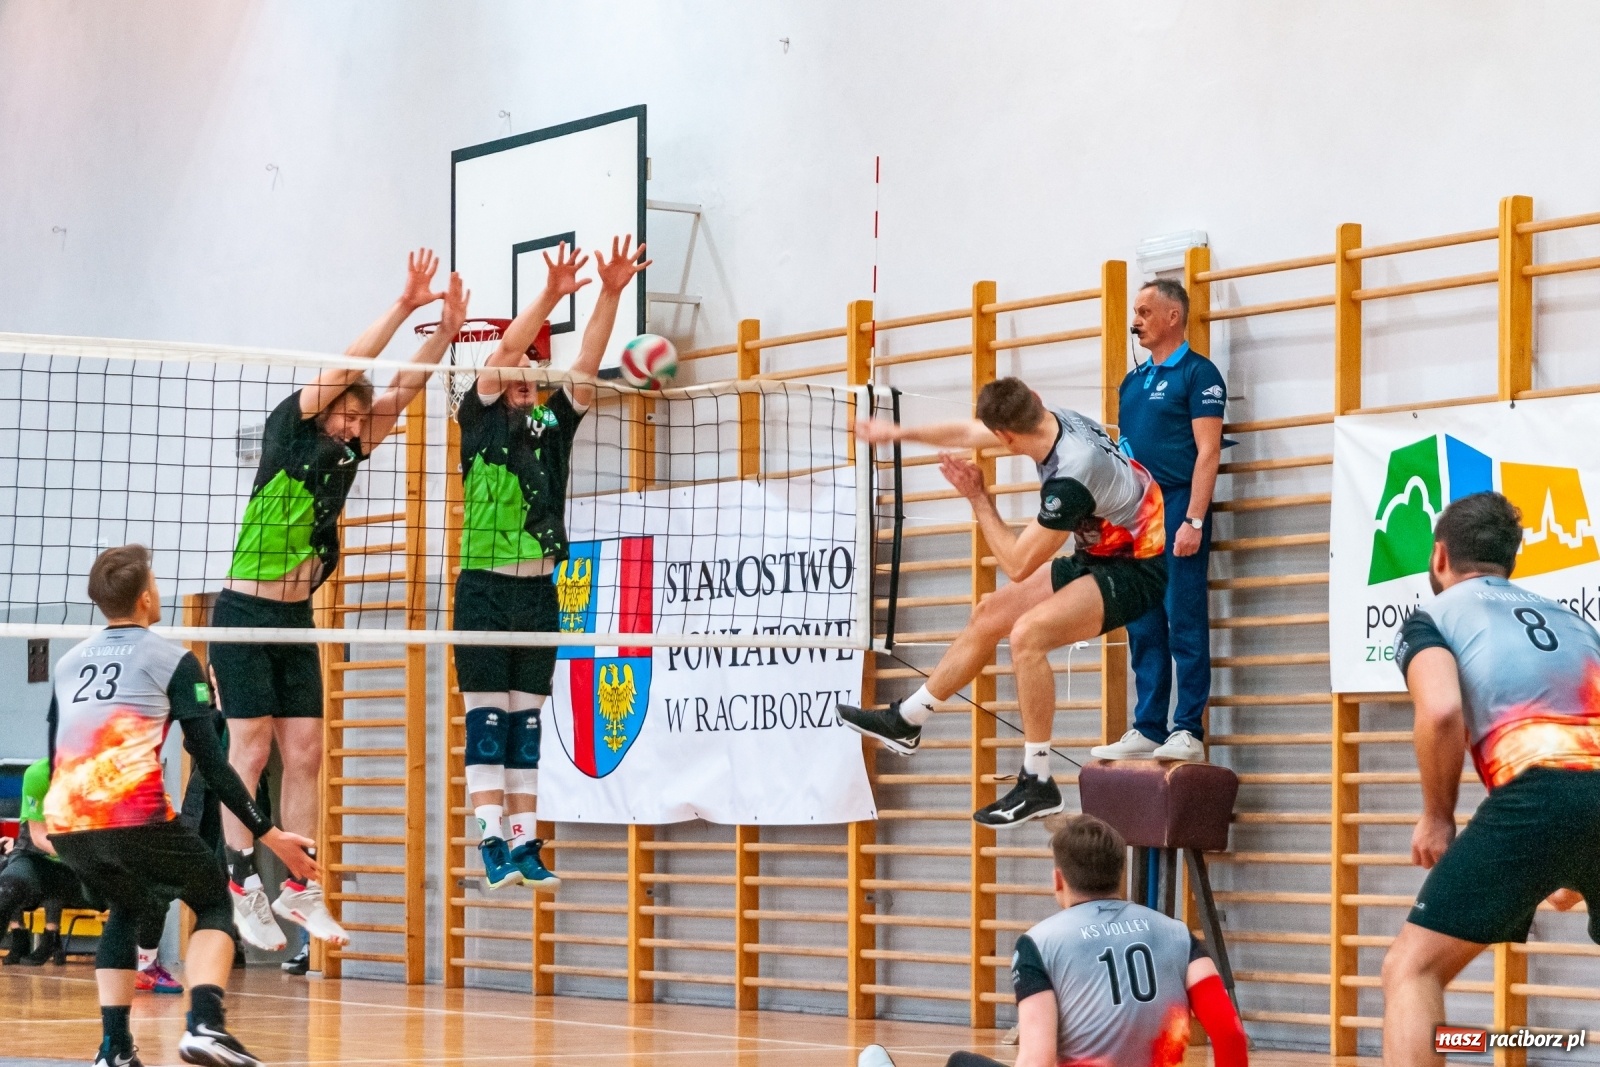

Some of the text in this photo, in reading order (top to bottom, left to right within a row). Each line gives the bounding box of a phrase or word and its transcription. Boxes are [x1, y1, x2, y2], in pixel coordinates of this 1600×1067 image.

[667, 546, 853, 604] STAROSTWO
[1512, 606, 1560, 653] 8
[81, 643, 136, 659] KS VOLLEY
[72, 662, 123, 704] 23
[664, 697, 690, 733] W
[1080, 918, 1150, 940] KS VOLLEY
[1096, 941, 1158, 1007] 10
